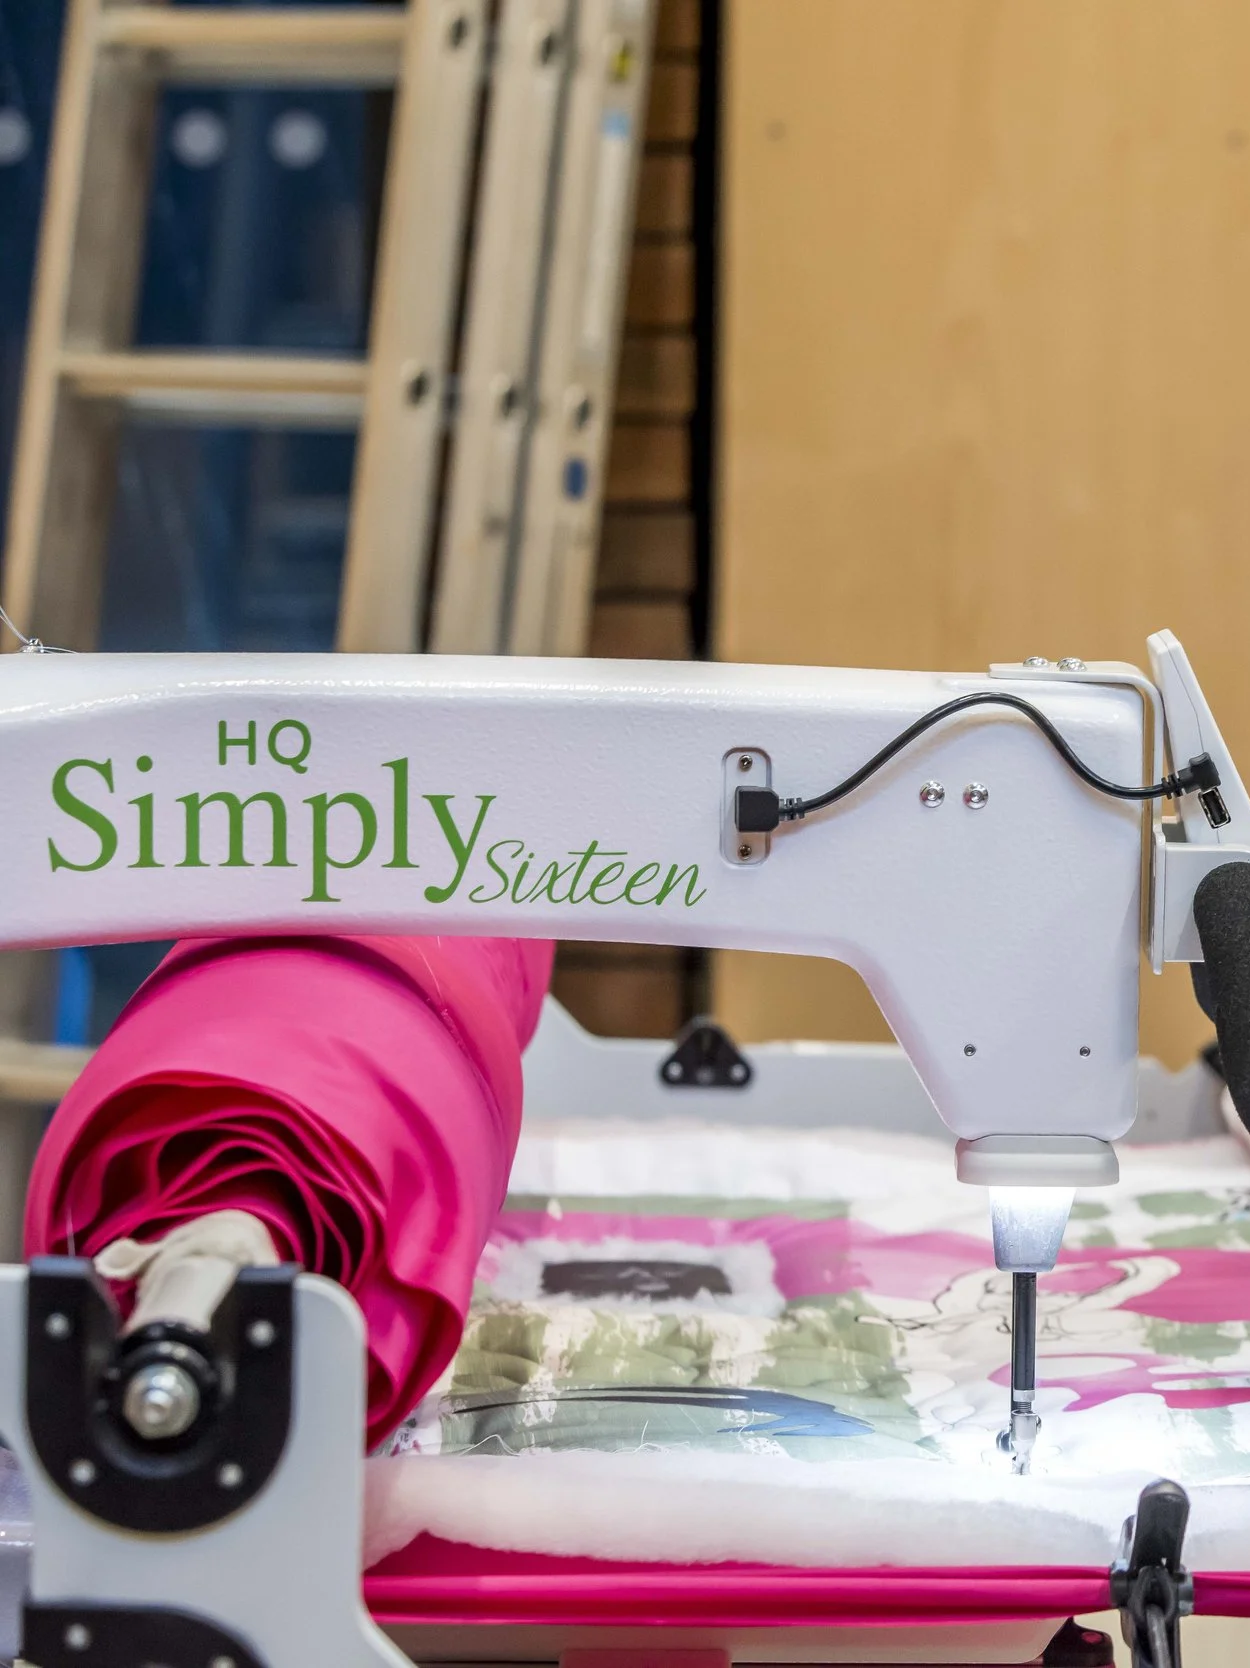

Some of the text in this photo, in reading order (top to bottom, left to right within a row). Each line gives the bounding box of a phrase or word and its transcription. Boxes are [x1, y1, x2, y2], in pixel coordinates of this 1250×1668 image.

[217, 719, 312, 774] HQ
[48, 756, 707, 907] Simply Sixteen
